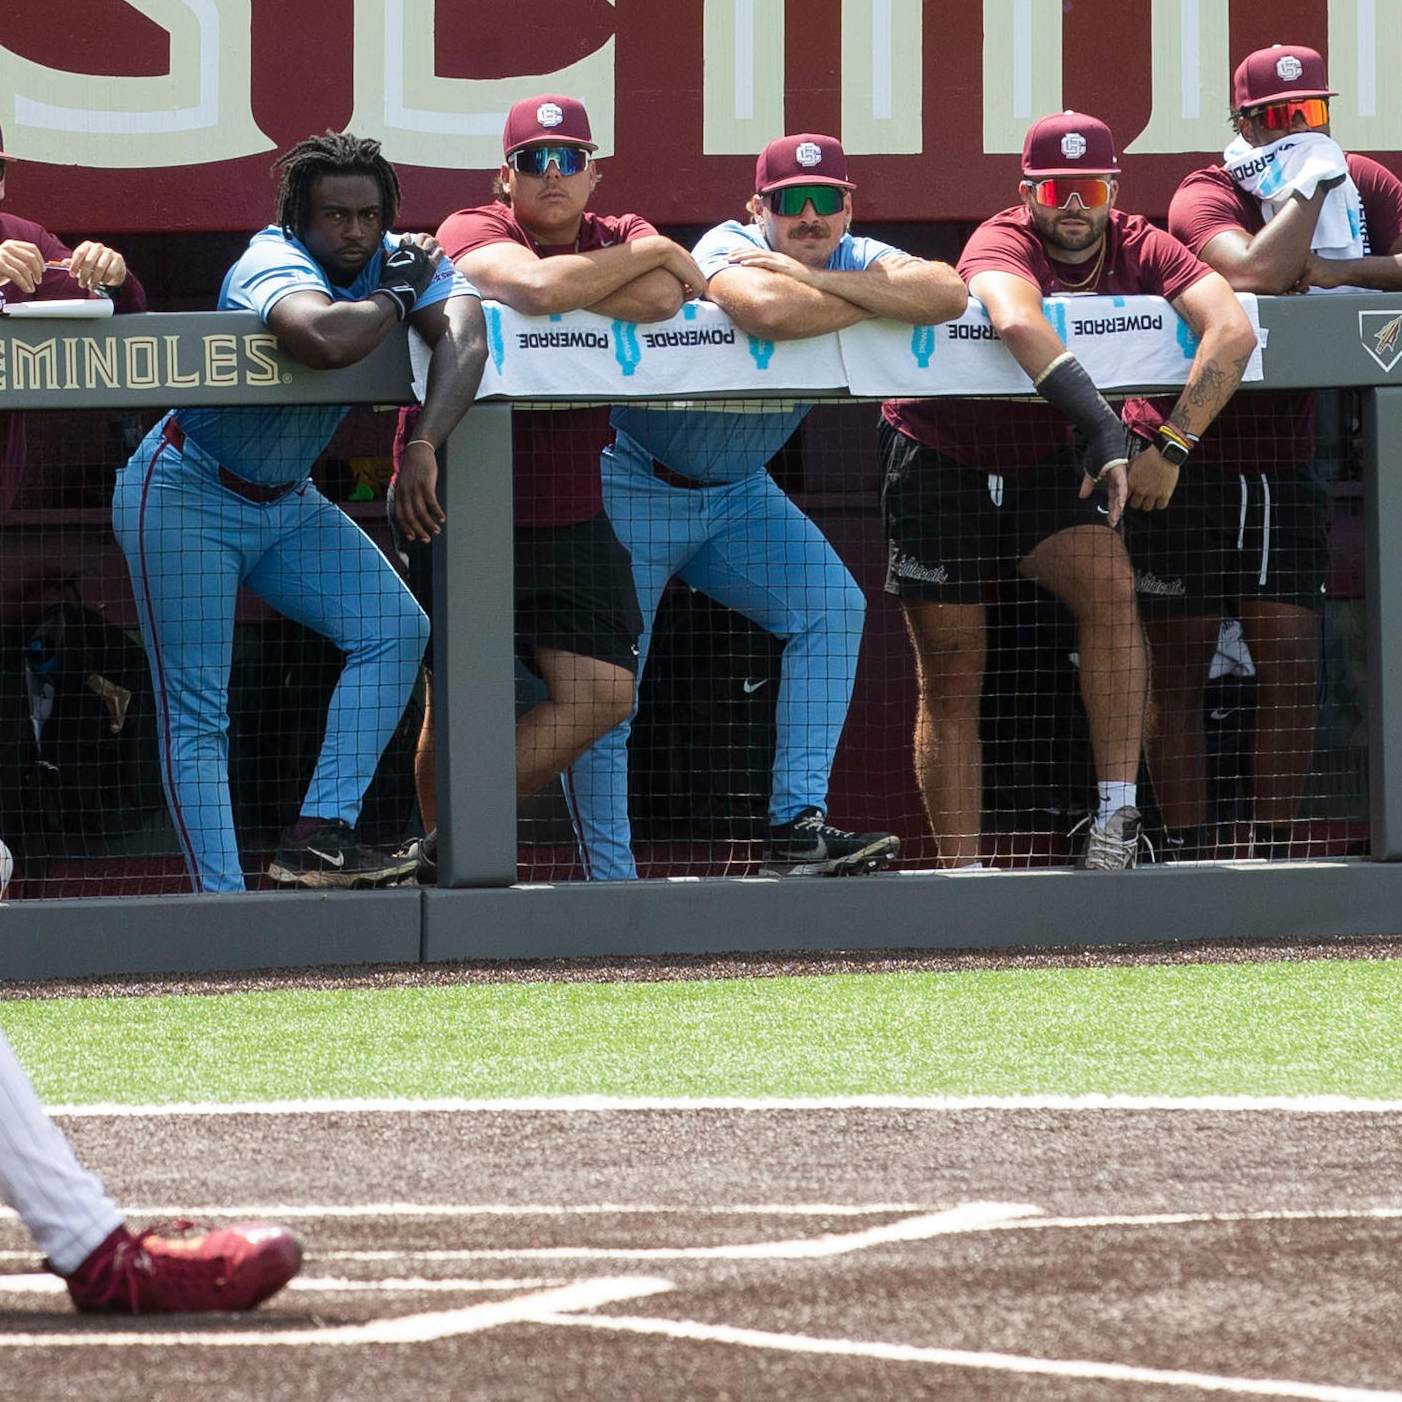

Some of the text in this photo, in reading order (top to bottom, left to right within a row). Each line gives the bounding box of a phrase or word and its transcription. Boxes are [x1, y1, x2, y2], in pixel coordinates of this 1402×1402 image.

[1073, 314, 1163, 336] POWERADE
[519, 332, 609, 350] POWERADE
[646, 329, 736, 348] POWERADE
